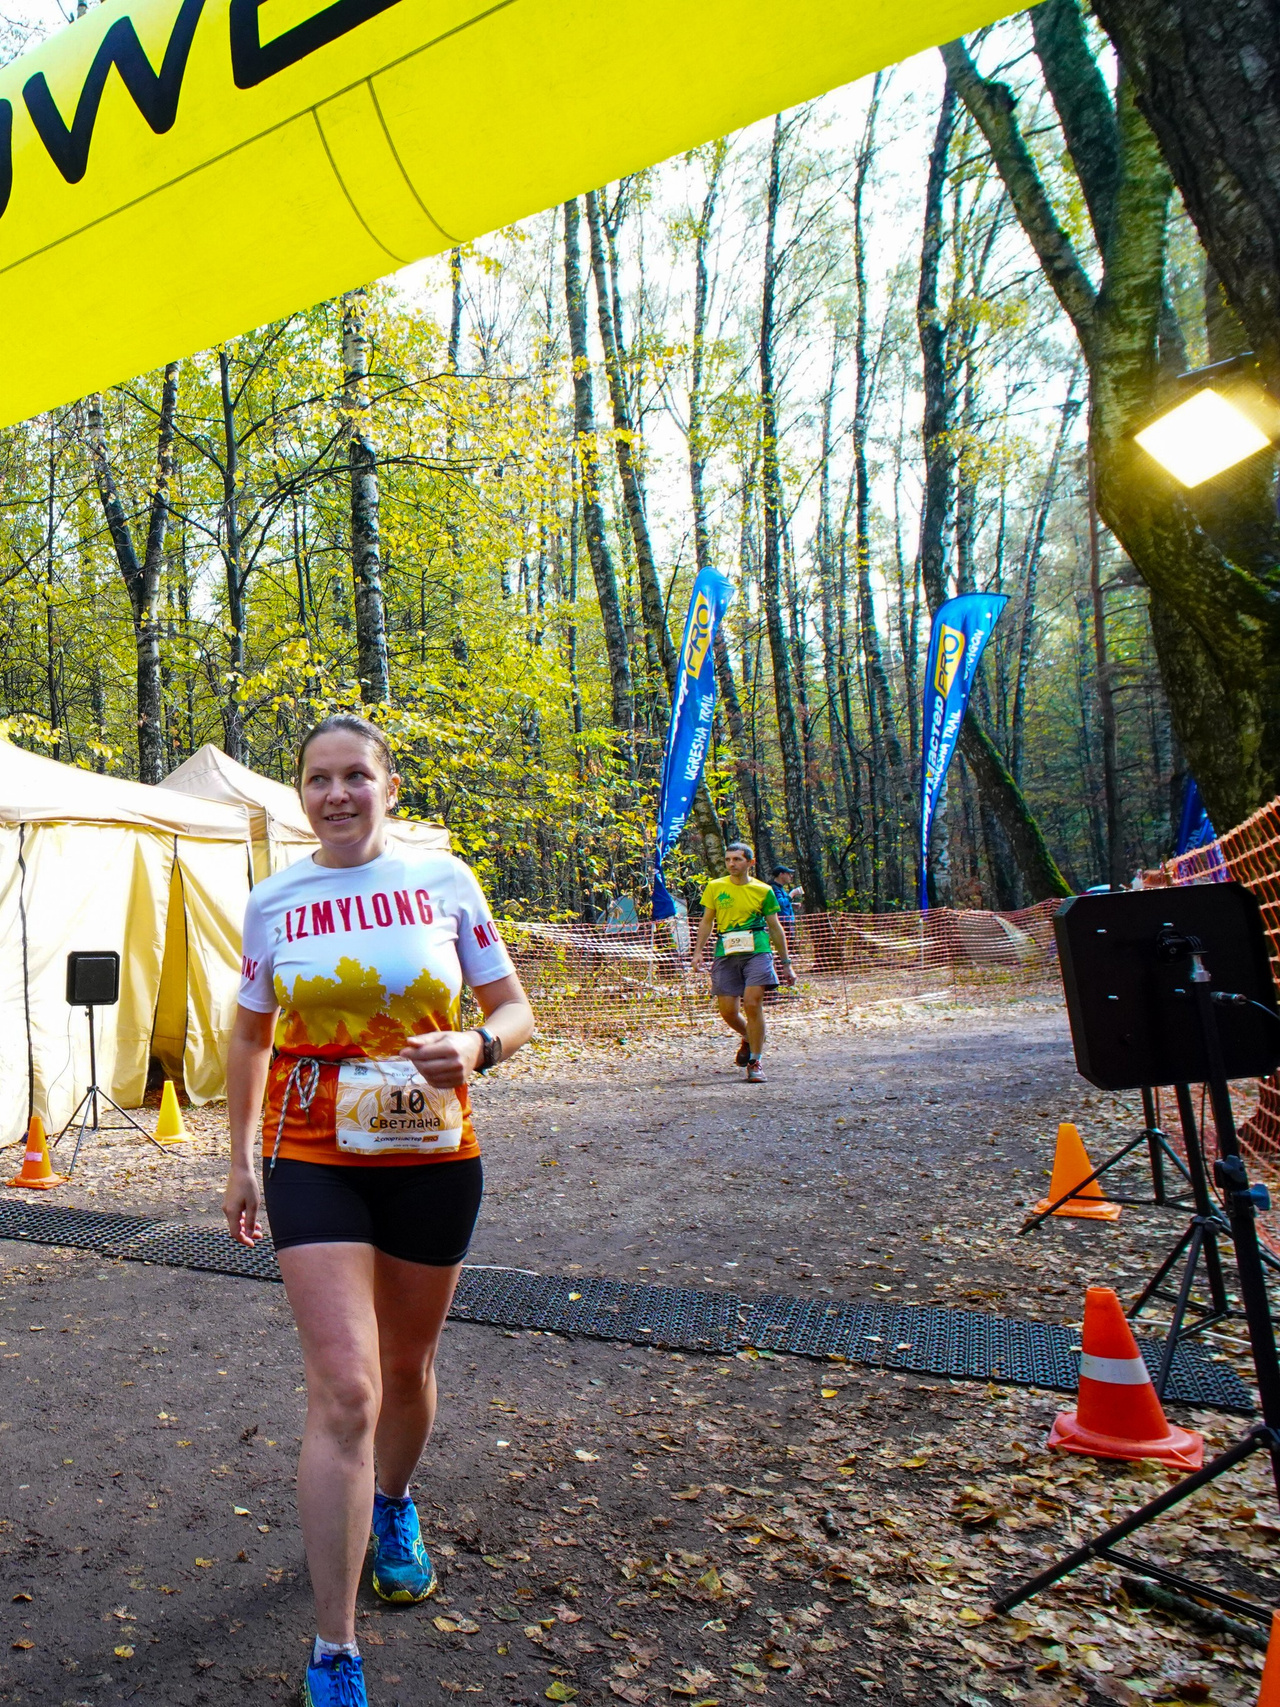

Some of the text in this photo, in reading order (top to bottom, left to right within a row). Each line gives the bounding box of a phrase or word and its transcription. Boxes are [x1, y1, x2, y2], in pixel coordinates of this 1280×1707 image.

[938, 633, 960, 694] PRO
[683, 692, 714, 781] UGRESHA TRAIL
[942, 708, 962, 740] TRAIL
[285, 889, 434, 943] IZMYLONG
[731, 937, 741, 945] 59
[390, 1089, 425, 1115] 10
[369, 1116, 441, 1129] Светлана
